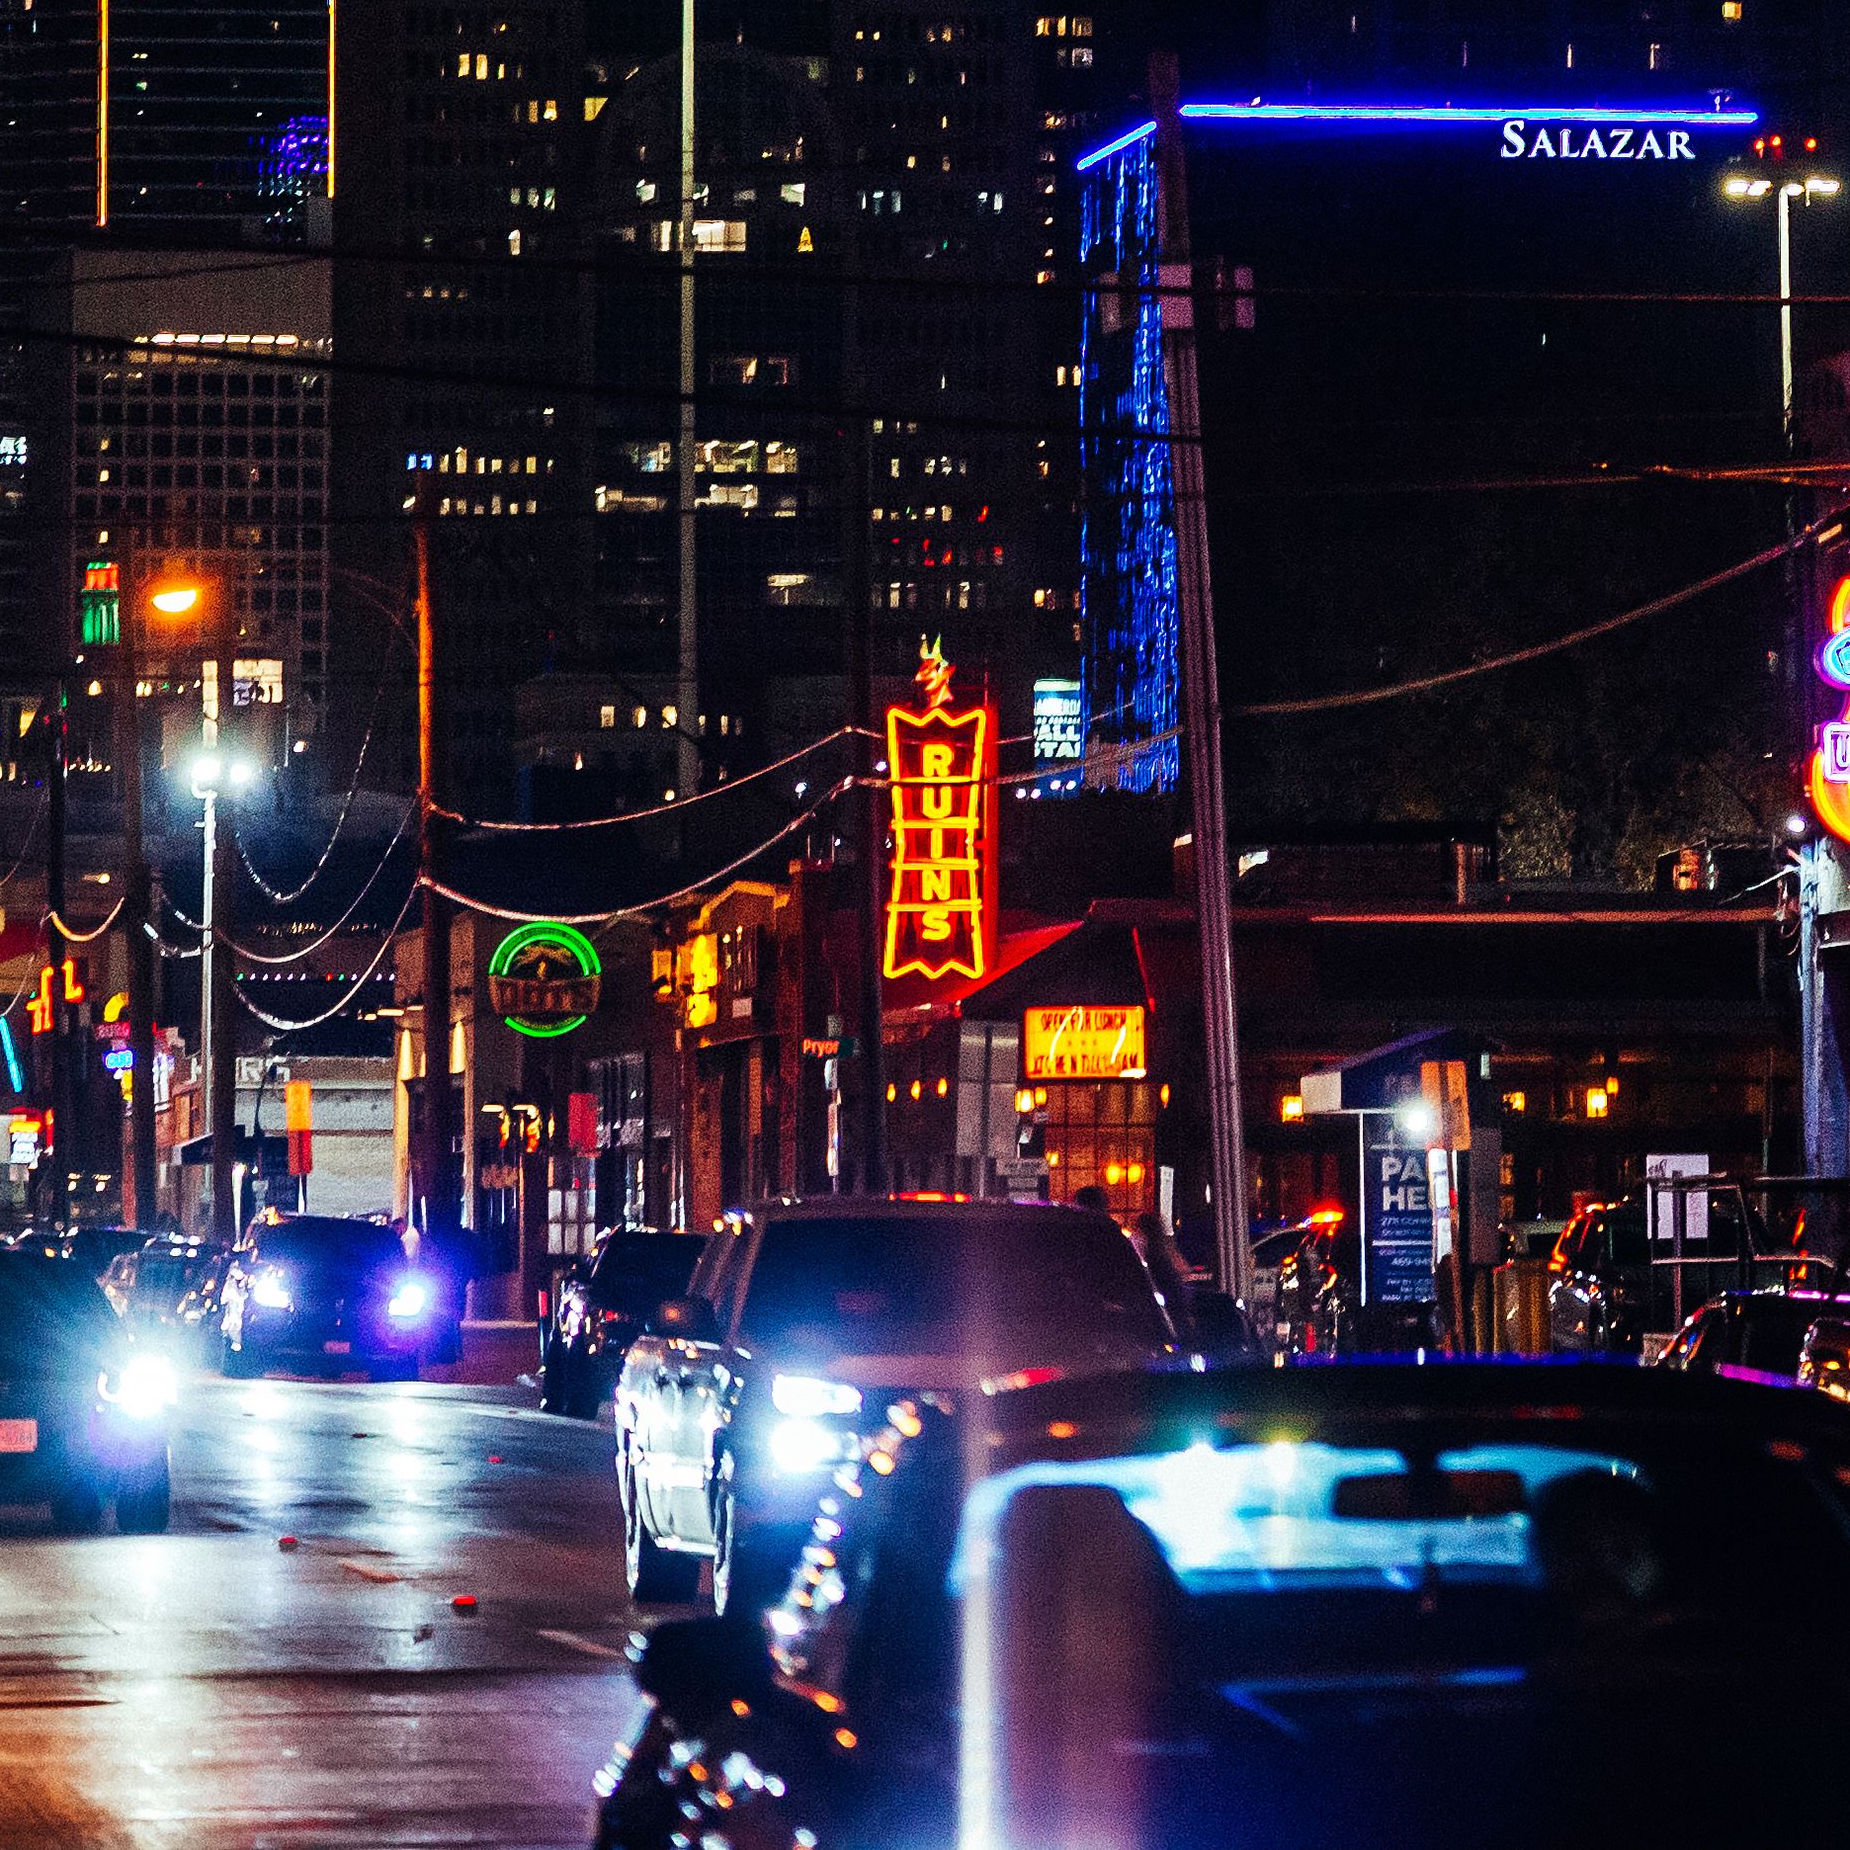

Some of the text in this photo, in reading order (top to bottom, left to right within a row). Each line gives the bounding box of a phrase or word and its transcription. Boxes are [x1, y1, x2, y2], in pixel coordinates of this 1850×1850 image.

[1500, 120, 1696, 160] SALAZAR
[921, 743, 954, 941] RUINS
[1381, 1155, 1426, 1182] PA
[1381, 1185, 1429, 1212] HE
